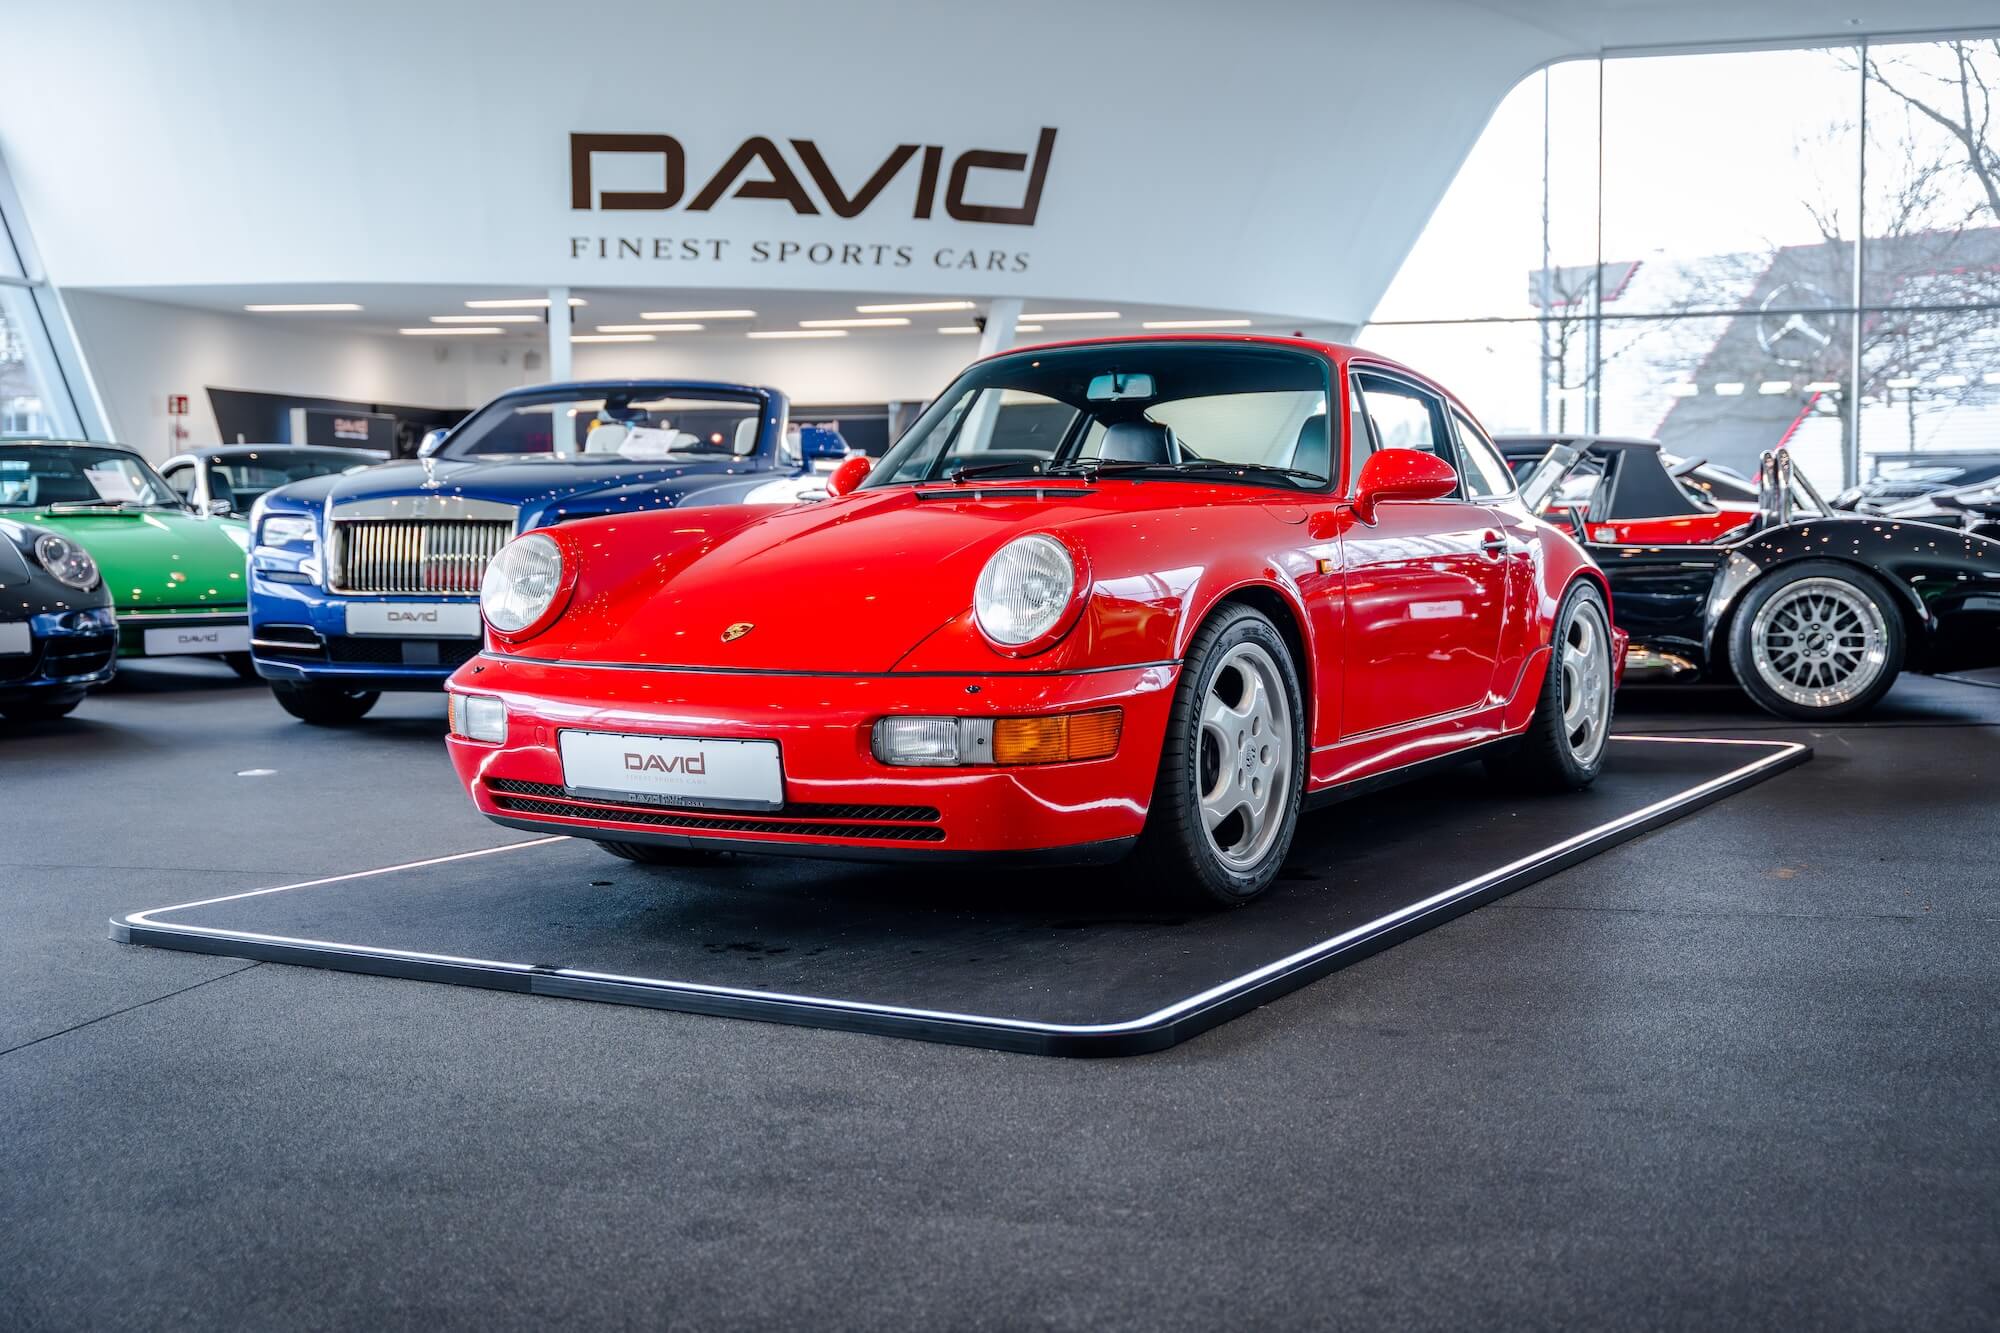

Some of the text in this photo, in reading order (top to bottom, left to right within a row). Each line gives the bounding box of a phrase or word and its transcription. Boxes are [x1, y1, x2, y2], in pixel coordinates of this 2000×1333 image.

[569, 236, 1030, 273] FINEST SPORTS CARS
[1189, 696, 1202, 783] MICHELIN
